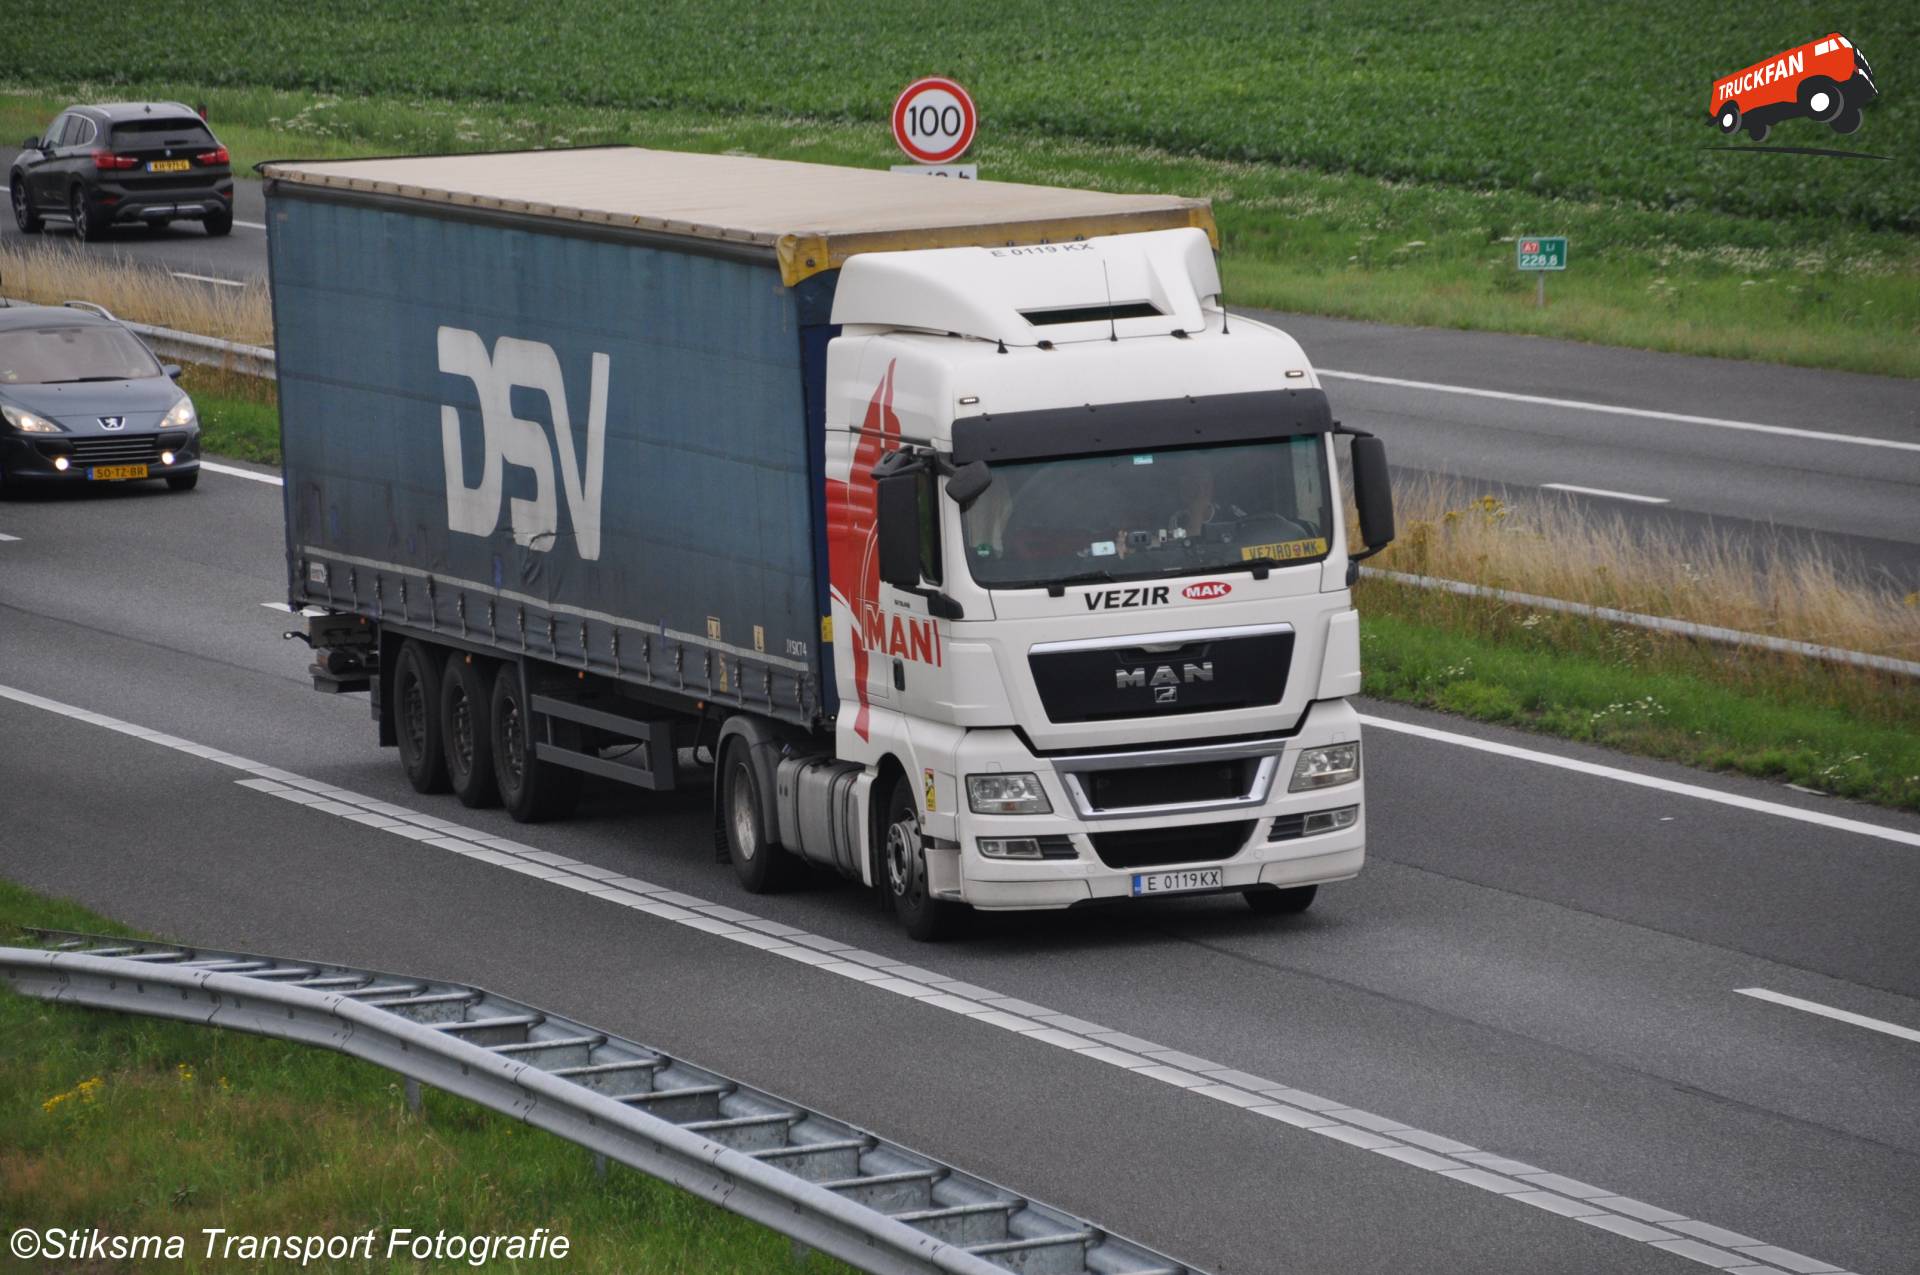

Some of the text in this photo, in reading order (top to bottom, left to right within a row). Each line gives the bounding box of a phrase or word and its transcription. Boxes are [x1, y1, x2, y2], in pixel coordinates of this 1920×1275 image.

[908, 104, 961, 137] 100
[991, 243, 1094, 258] E 0119 KX
[1524, 243, 1538, 253] A7
[437, 325, 610, 562] DSV
[1084, 583, 1227, 611] VEZIR MAK
[864, 606, 934, 665] MAN
[1115, 661, 1214, 689] MAN
[1147, 871, 1219, 891] E 0119KX
